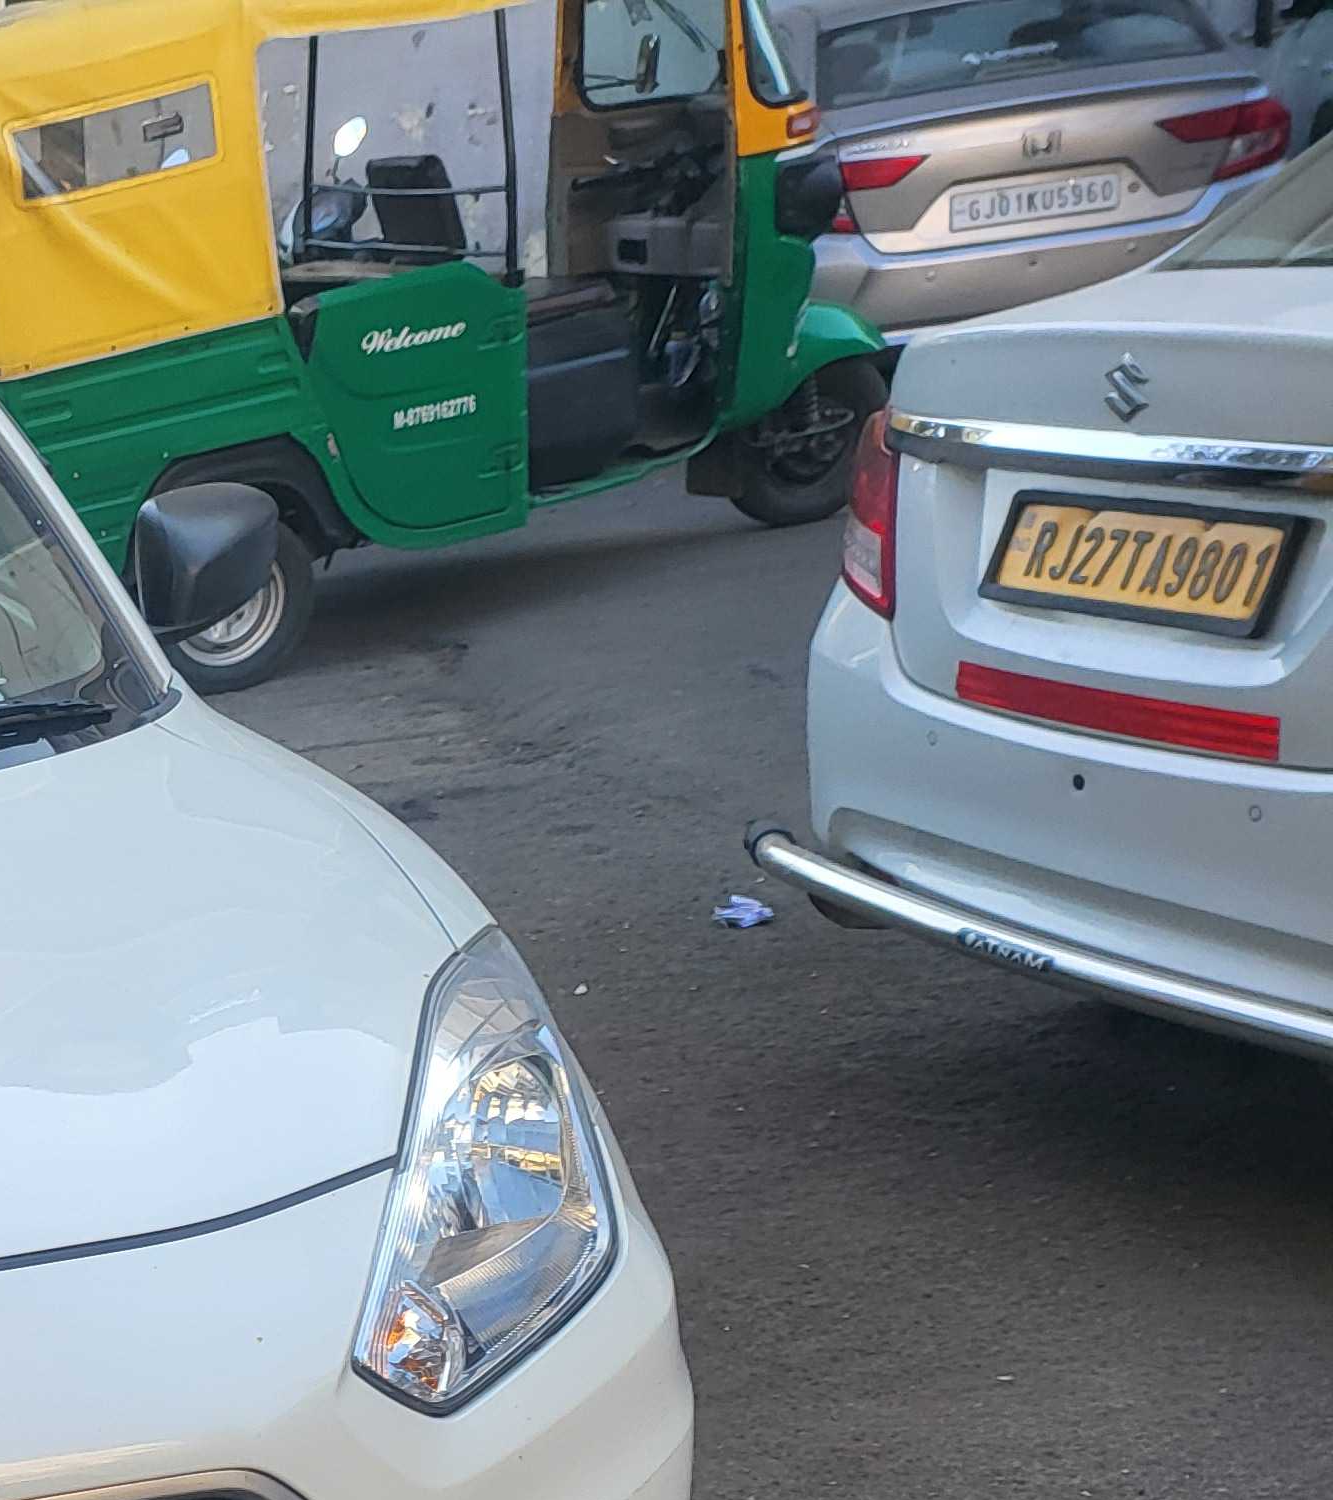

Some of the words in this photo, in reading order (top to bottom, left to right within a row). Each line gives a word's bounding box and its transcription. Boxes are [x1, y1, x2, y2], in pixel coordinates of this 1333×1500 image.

[968, 180, 1115, 221] GJ01KU5960
[361, 321, 467, 355] Welcome
[1023, 520, 1276, 608] RJ27TA9801
